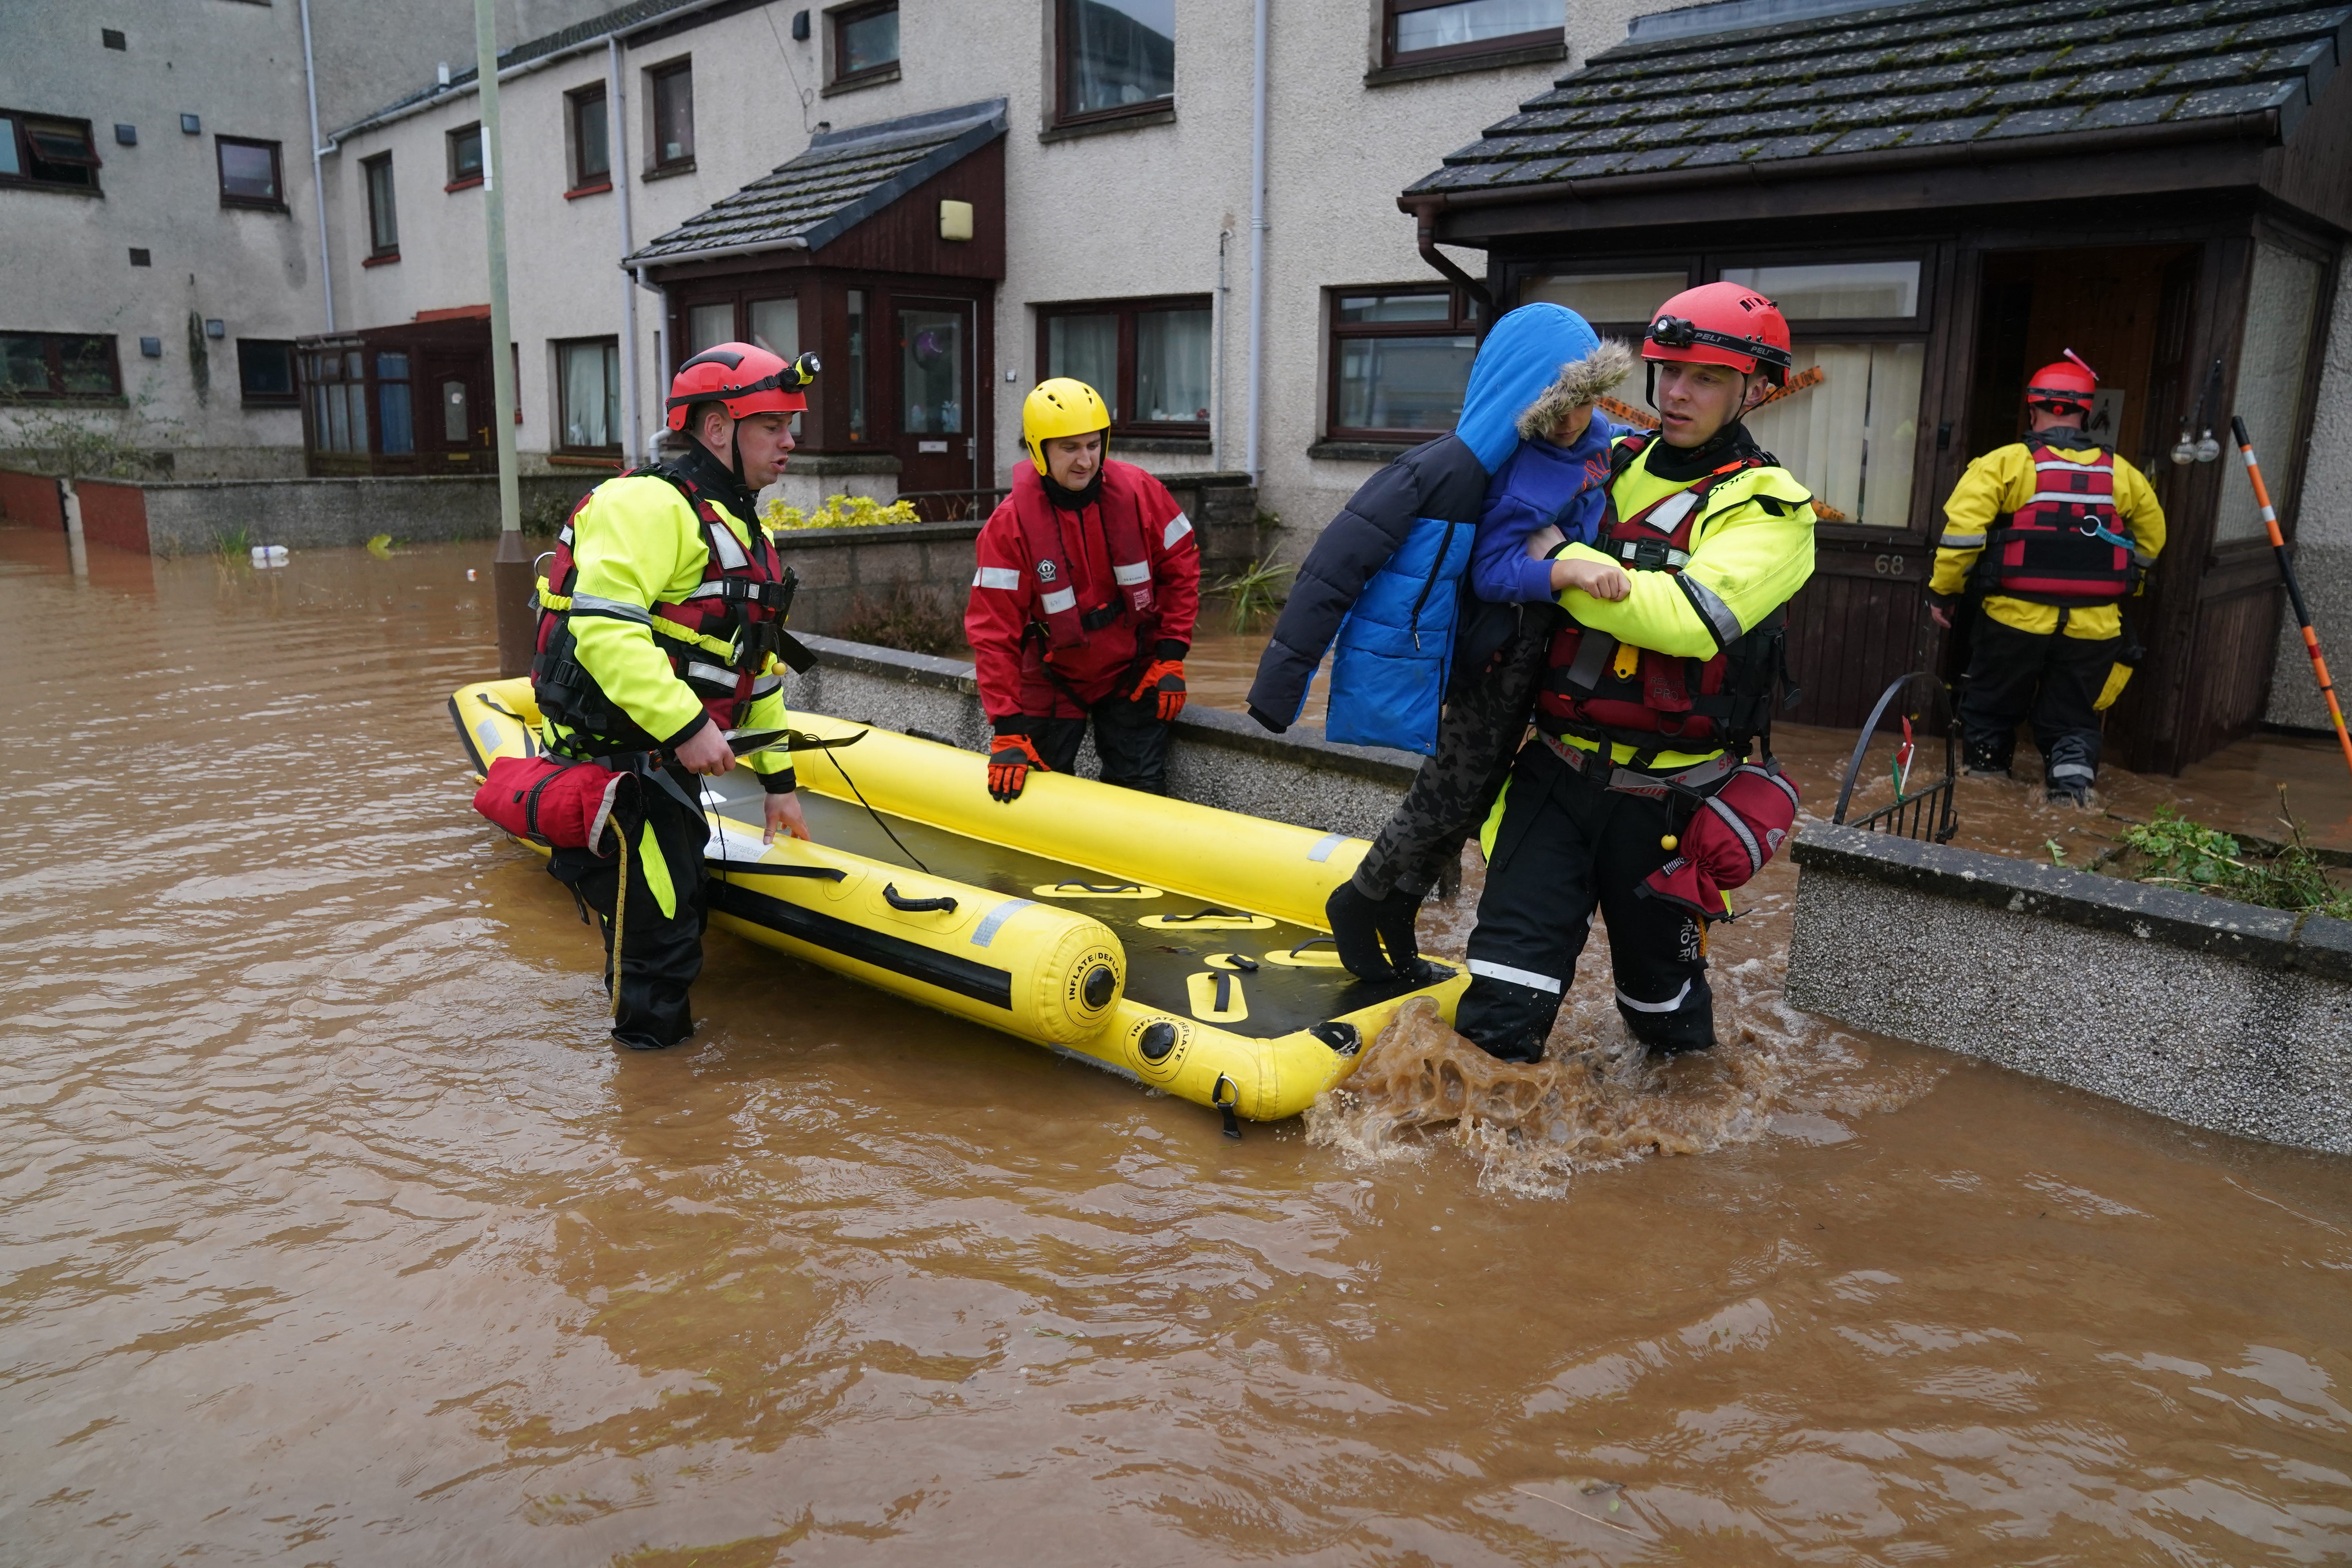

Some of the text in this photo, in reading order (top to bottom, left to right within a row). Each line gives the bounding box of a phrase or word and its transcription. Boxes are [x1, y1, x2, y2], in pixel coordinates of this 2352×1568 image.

[1875, 554, 1904, 575] 68
[1653, 688, 1678, 701] PRO
[1767, 830, 1779, 846] 20
